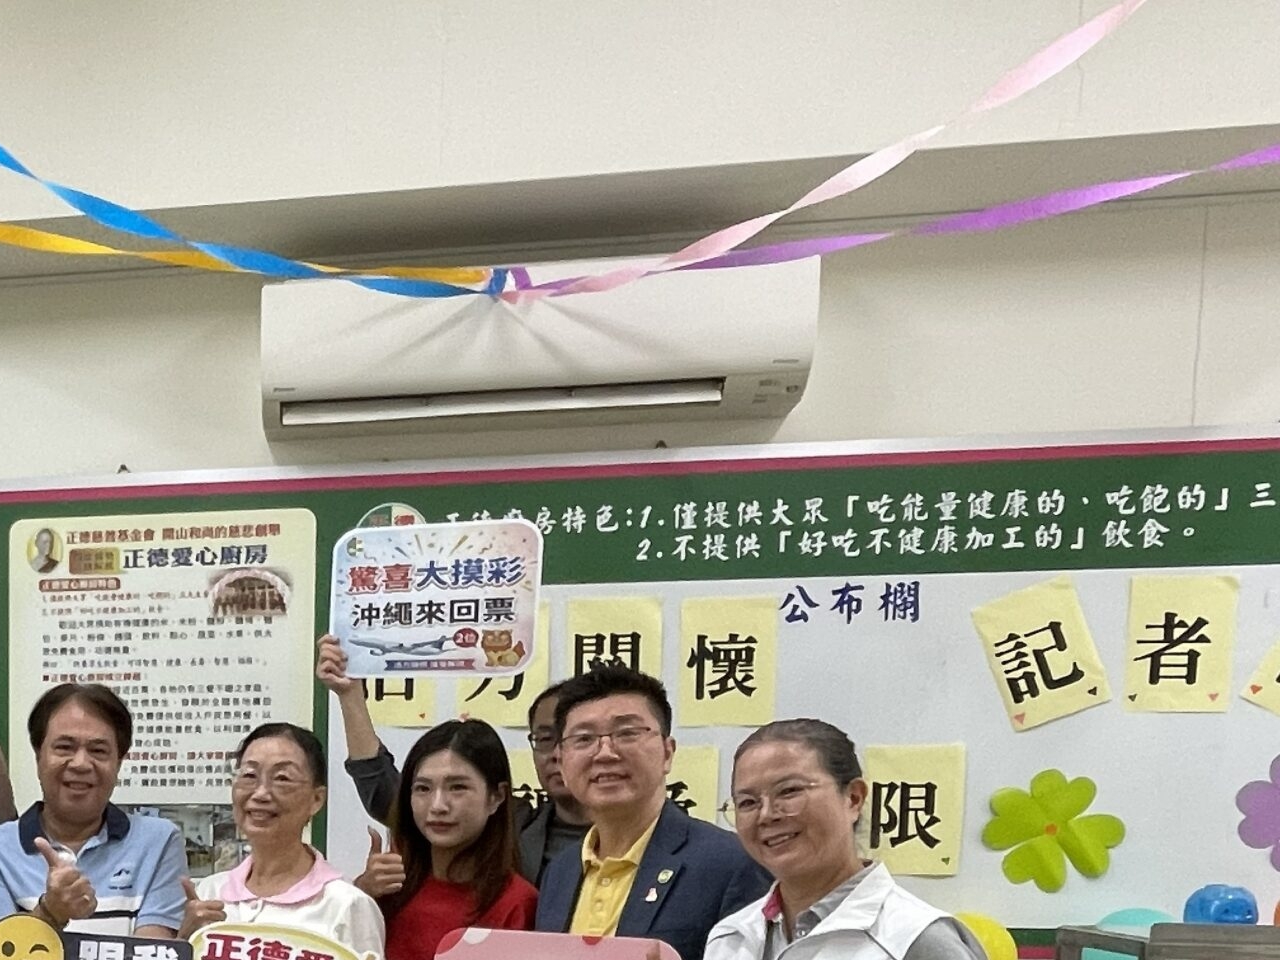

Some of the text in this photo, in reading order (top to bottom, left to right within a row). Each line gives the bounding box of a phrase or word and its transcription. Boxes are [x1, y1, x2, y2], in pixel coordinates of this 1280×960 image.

[122, 544, 267, 569] 正德愛心廚房
[348, 556, 526, 592] 驚喜大摸彩
[351, 597, 517, 627] 沖繩來回票
[779, 581, 920, 625] 公布欄
[994, 612, 1211, 704] 記者
[871, 781, 943, 850] 限
